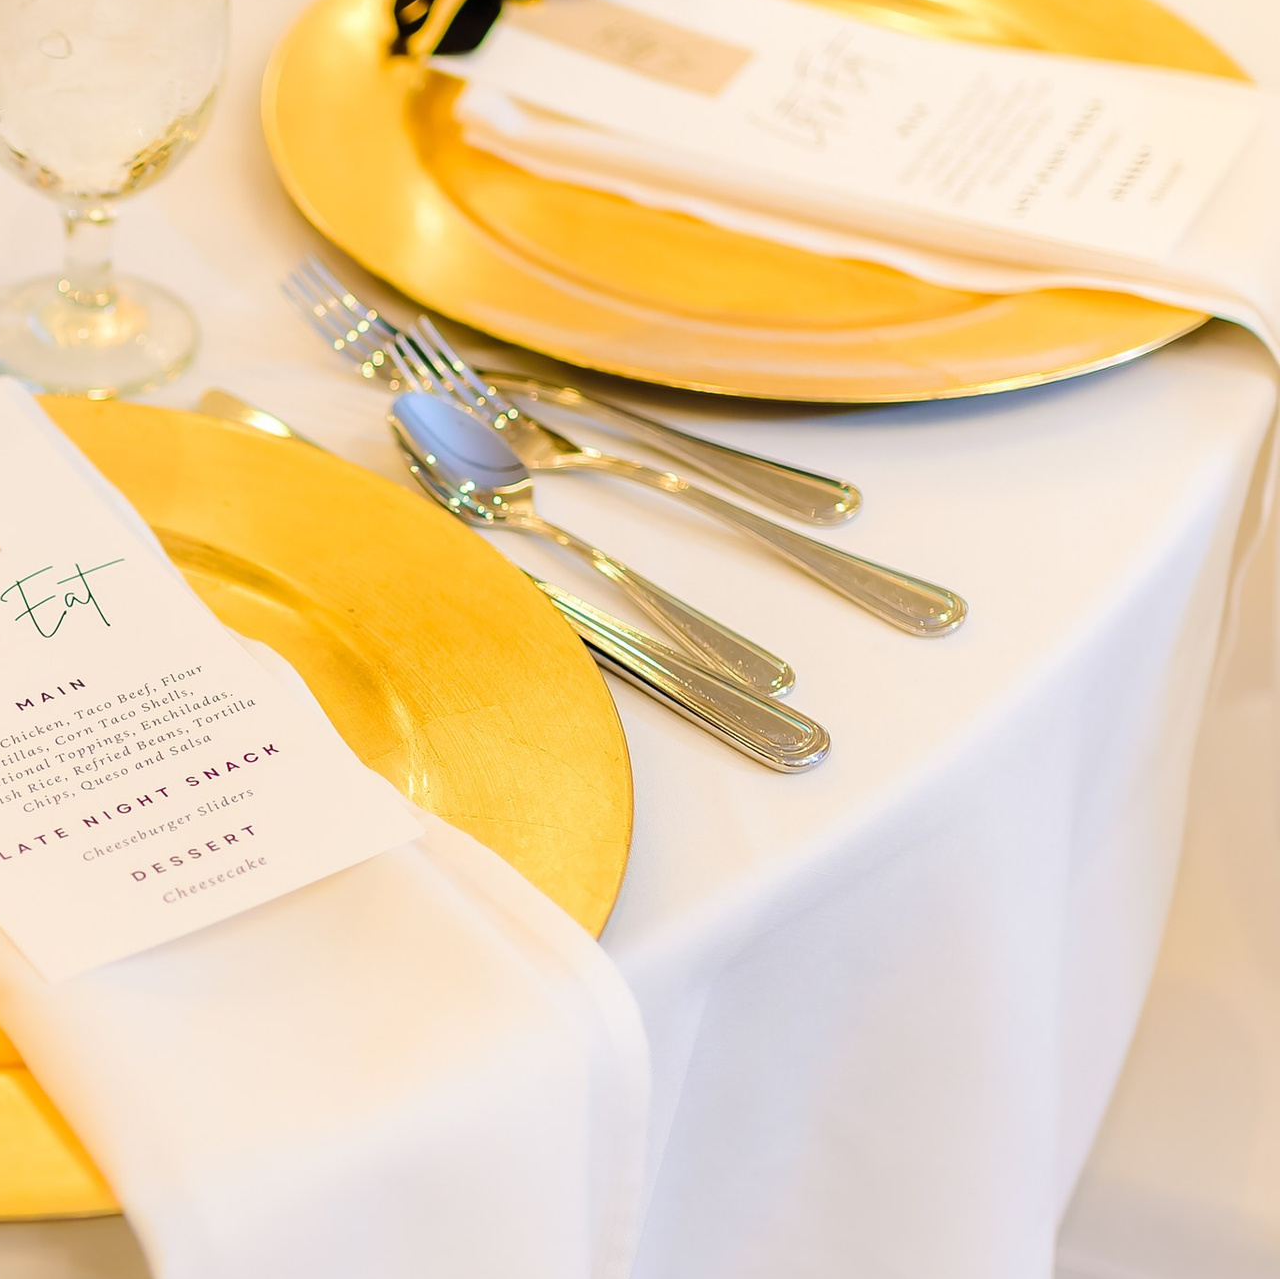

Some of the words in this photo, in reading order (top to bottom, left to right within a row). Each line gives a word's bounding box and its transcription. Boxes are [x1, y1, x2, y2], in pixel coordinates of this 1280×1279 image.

[1, 558, 125, 638] Eat
[0, 719, 70, 749] Chicken,
[74, 701, 112, 721] Taco
[117, 683, 157, 704] Beef,
[161, 665, 203, 687] Flour
[15, 679, 86, 711] MAIN
[55, 727, 94, 746] Corn
[98, 711, 136, 729] Taco
[141, 689, 194, 713] Shells,
[23, 790, 76, 813] Chips,
[80, 768, 129, 791] Queso
[135, 751, 165, 770] and
[170, 734, 212, 756] Salsa
[27, 775, 68, 794] Rice,
[73, 746, 131, 776] Refried
[136, 727, 189, 751] Beans,
[193, 699, 256, 728] Tortilla
[55, 729, 136, 764] Toppings,
[82, 787, 170, 827] NIGHT
[185, 744, 280, 787] SNACK
[82, 814, 192, 862] Cheeseburger
[197, 788, 254, 817] Sliders
[130, 825, 255, 882] DESSERT
[162, 855, 268, 904] Cheesecake
